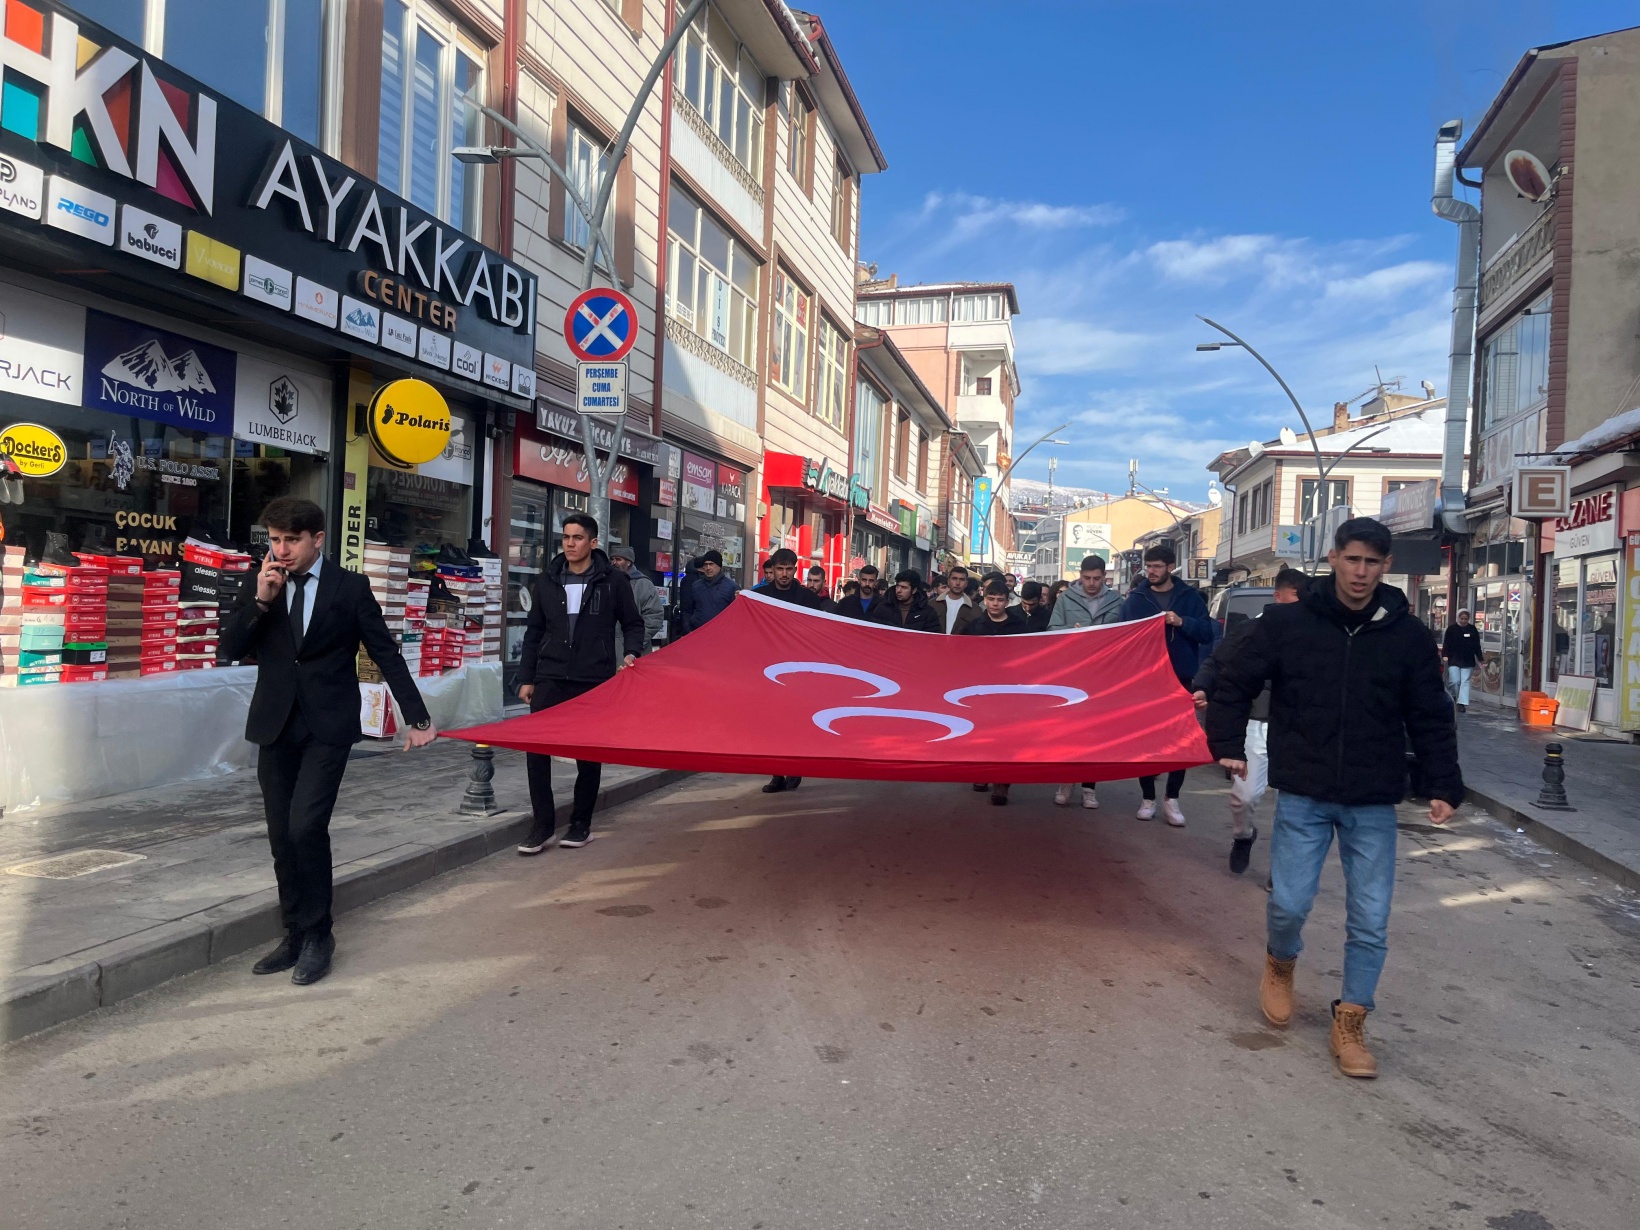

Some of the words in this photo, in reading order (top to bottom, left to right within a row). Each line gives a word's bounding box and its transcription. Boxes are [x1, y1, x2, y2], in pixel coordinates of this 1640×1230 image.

[57, 198, 110, 227] REGO
[256, 139, 533, 335] AYAKKABI
[127, 232, 177, 261] babucci
[363, 271, 456, 332] CENTER
[585, 368, 618, 380] PERŞEMBE
[592, 382, 611, 393] CUMA
[100, 378, 159, 412] NORTH
[163, 403, 175, 412] OF
[176, 395, 216, 423] WILD
[583, 395, 619, 407] CUMARTESİ
[395, 411, 450, 432] Polaris
[540, 407, 578, 436] YAVUZ
[248, 421, 317, 448] LUMBERJACK
[19, 461, 28, 469] by
[29, 461, 45, 469] Gerli
[137, 455, 156, 471] U.S.
[159, 460, 189, 475] POLO
[686, 461, 712, 479] emsan
[161, 474, 181, 484] SINCE
[721, 482, 741, 498] KARACA
[1528, 477, 1556, 507] E
[115, 511, 177, 530] ÇOCUK
[1570, 533, 1590, 548] GÜVEN
[1006, 552, 1032, 561] AVUKAT
[194, 567, 217, 578] alessio
[192, 584, 217, 595] alessio
